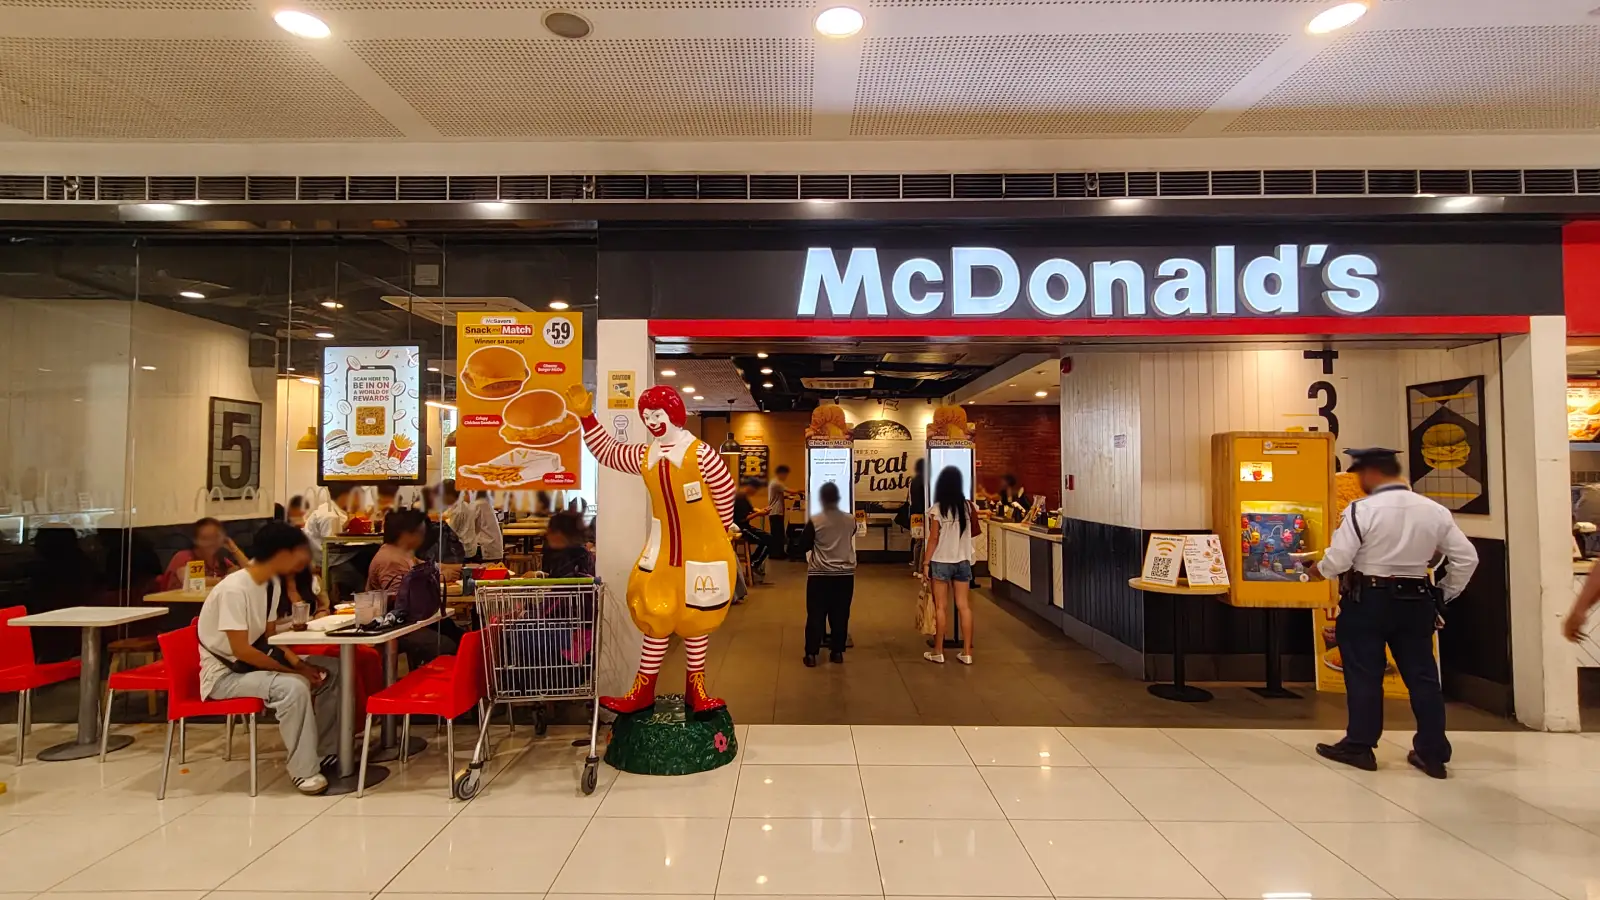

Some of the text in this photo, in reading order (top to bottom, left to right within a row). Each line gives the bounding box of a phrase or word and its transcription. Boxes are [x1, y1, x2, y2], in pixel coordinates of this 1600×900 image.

[796, 244, 1381, 317] McDonald's
[465, 326, 492, 334] Snack
[502, 325, 532, 334] Match
[220, 411, 252, 489] 5
[190, 565, 203, 574] 37
